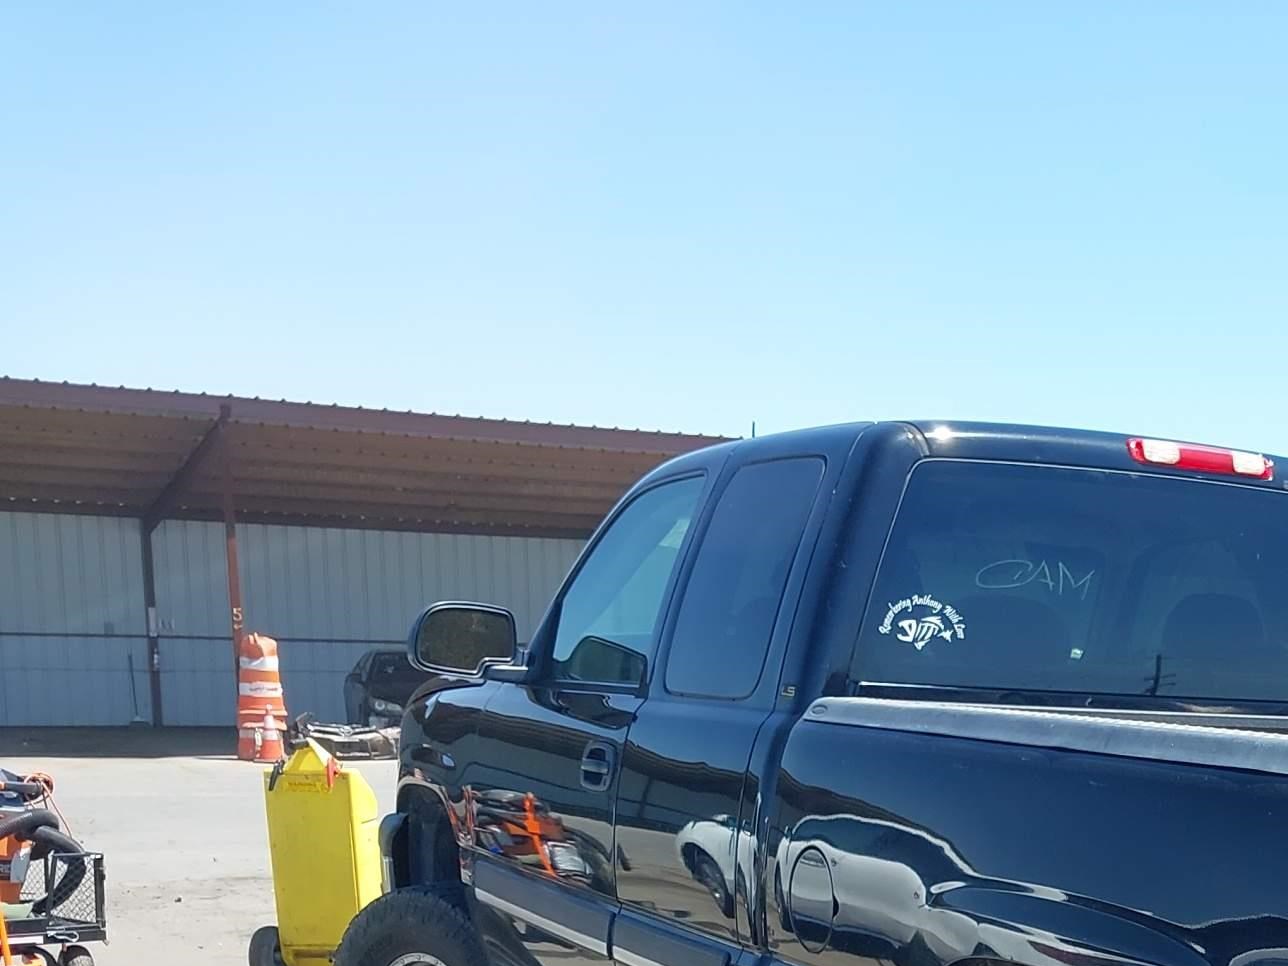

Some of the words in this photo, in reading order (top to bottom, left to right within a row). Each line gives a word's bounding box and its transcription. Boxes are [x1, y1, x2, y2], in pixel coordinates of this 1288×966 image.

[232, 607, 242, 621] 5
[911, 594, 943, 614] Anthony
[943, 605, 963, 624] With
